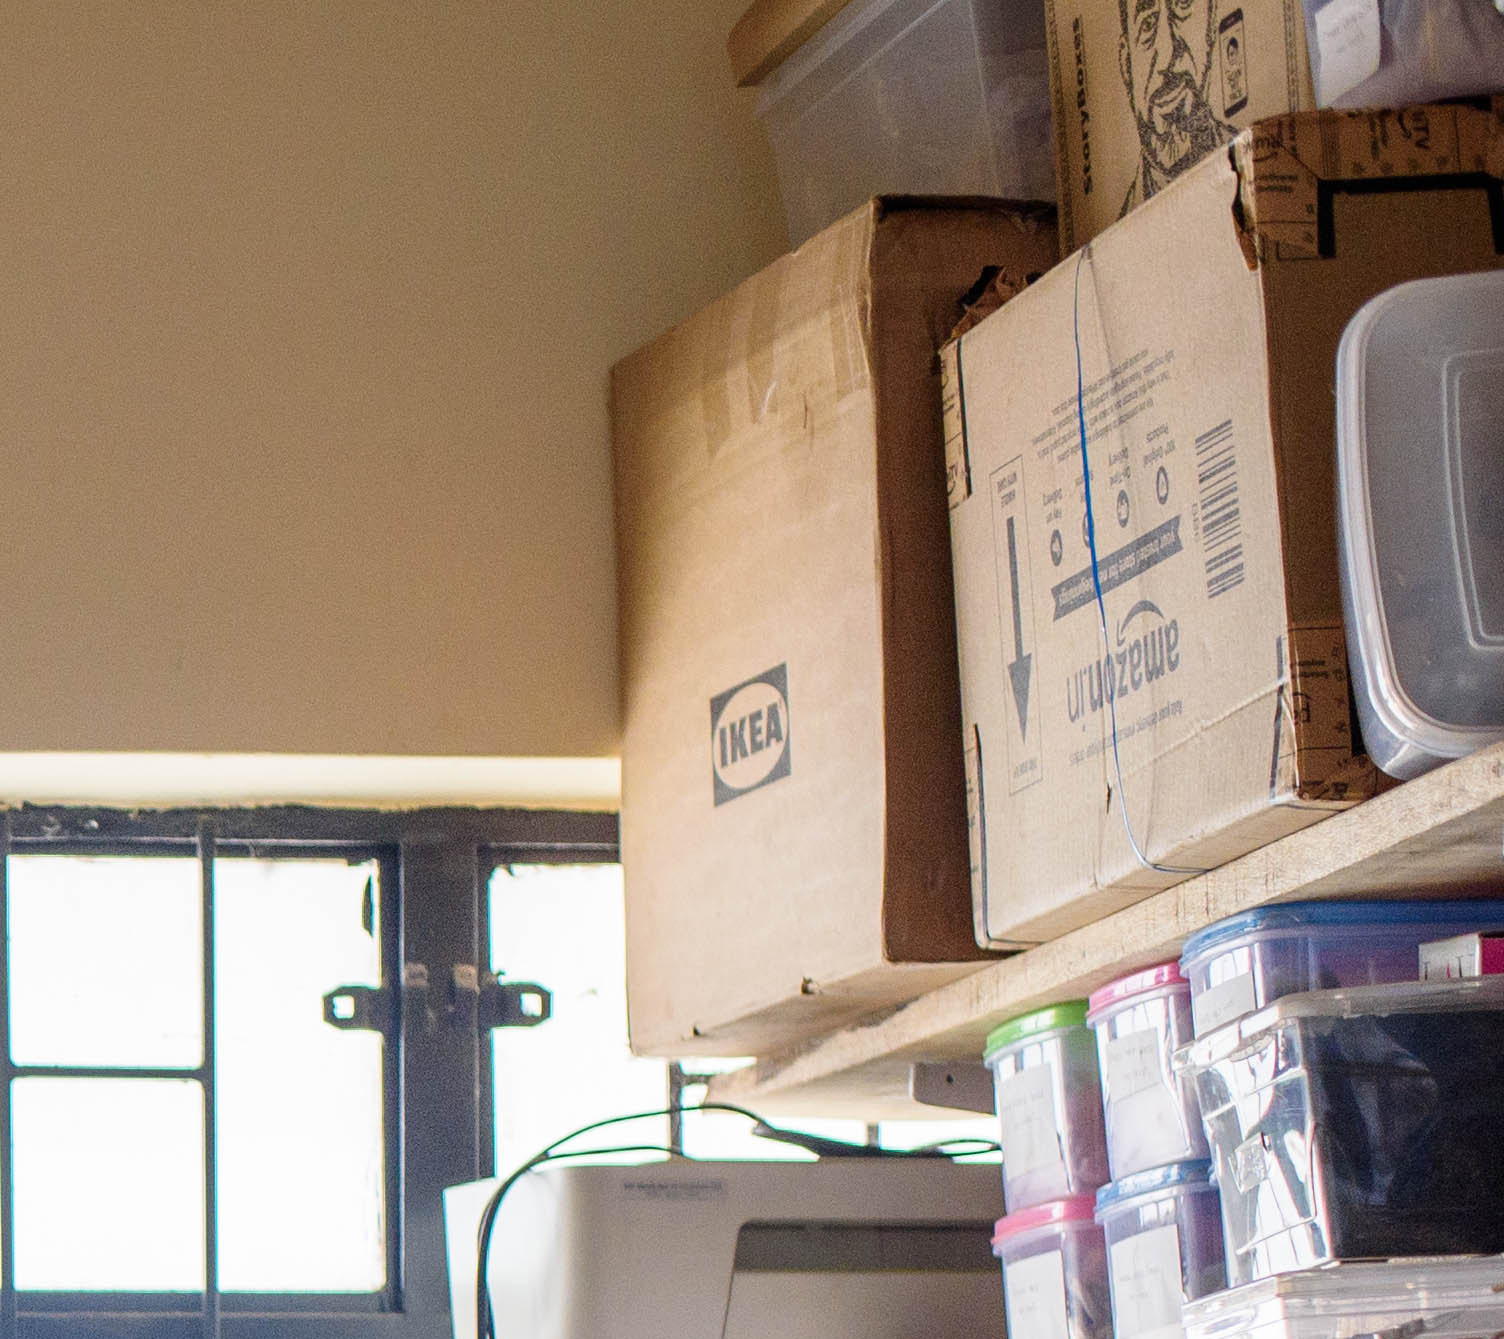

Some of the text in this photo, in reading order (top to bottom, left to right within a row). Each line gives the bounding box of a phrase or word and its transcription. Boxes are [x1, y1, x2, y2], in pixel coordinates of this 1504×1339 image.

[1072, 16, 1092, 196] StoryBoxes
[1066, 618, 1181, 732] amazon.in
[717, 698, 785, 770] IKEA
